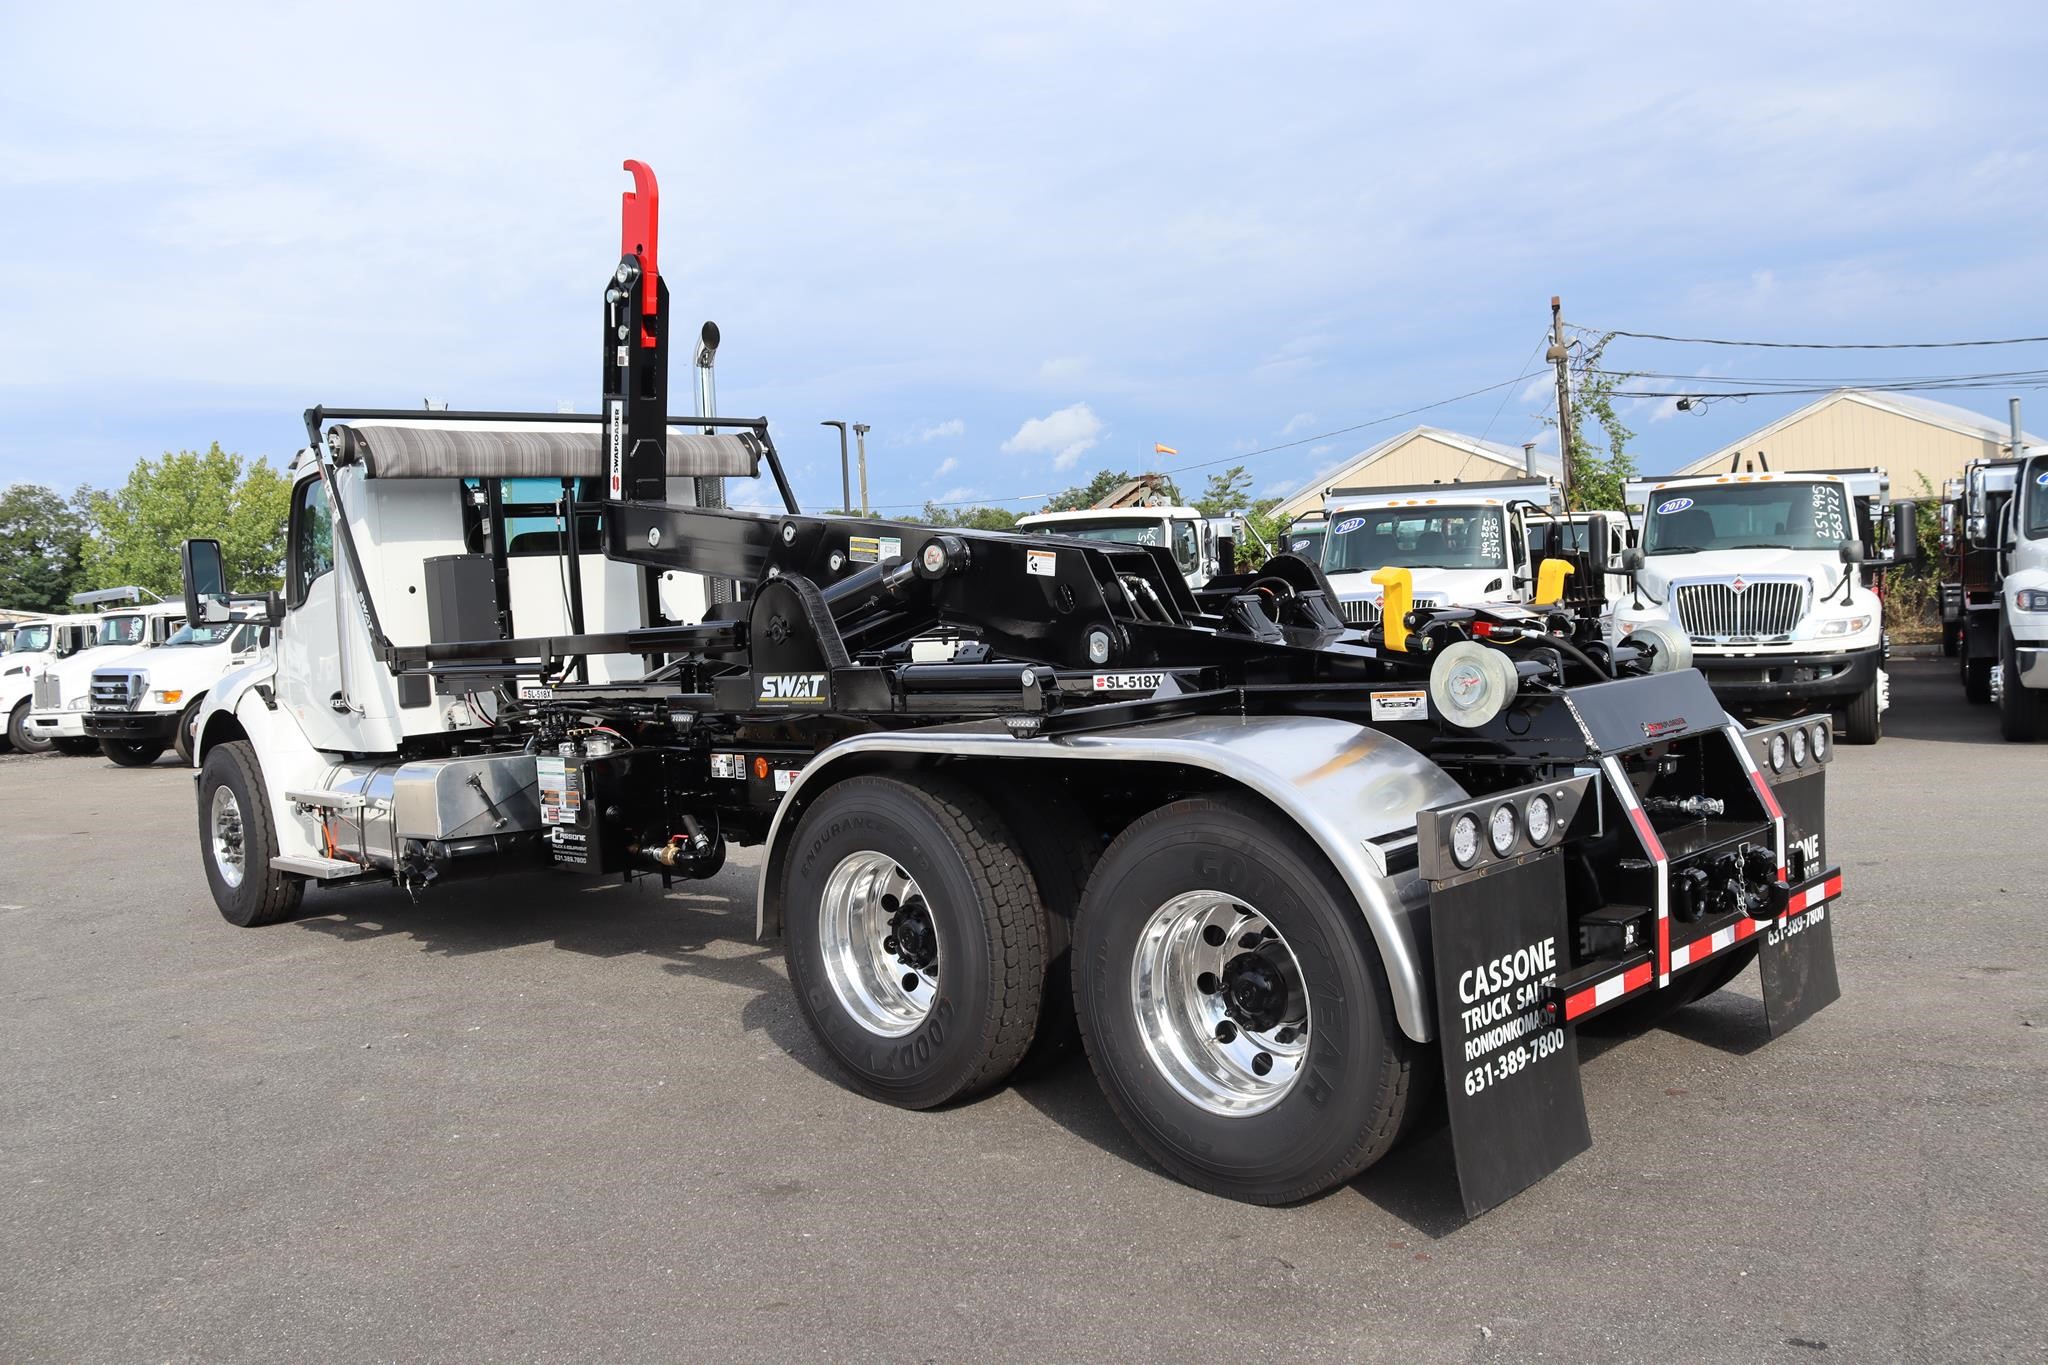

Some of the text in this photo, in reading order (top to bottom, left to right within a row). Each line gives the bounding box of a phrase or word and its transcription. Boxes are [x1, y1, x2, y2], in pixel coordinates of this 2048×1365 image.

[1663, 499, 1687, 513] 2019
[1826, 486, 1846, 540] 563727
[1340, 519, 1359, 533] 2021
[1490, 517, 1501, 559] 554230
[527, 689, 550, 699] SL-518X
[760, 674, 825, 698] SWAT
[1106, 675, 1161, 689] SL-518X
[1459, 936, 1557, 1005] CASSONE
[1461, 993, 1513, 1034] TRUCK
[1464, 1028, 1565, 1097] 631-389-7800
